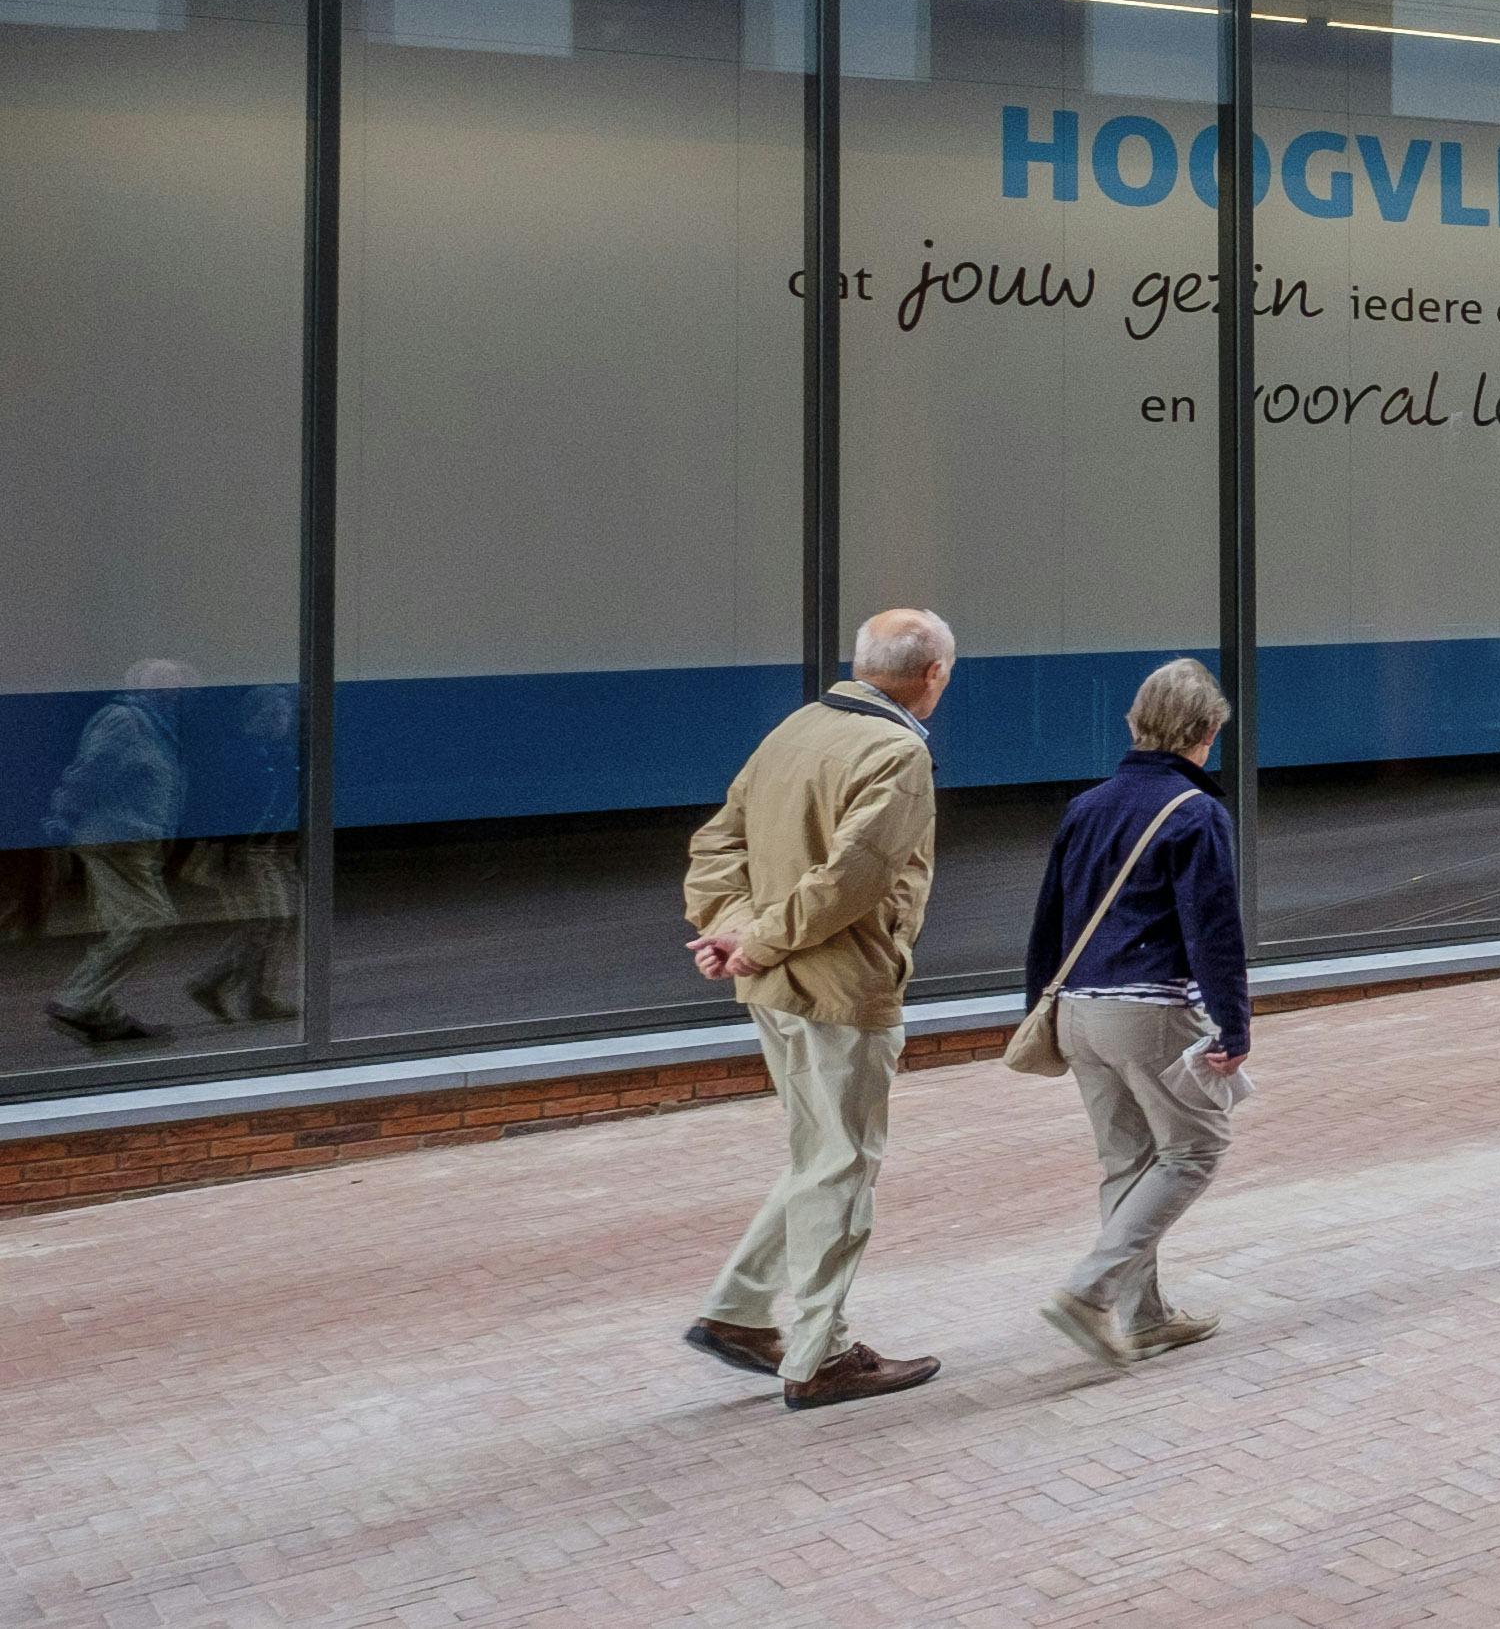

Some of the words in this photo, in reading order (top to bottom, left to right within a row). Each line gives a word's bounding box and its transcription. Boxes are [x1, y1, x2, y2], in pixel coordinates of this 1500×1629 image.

[898, 239, 1096, 332] jouw
[1350, 285, 1483, 325] iedere
[1140, 395, 1196, 423] en
[1254, 370, 1449, 426] ooral
